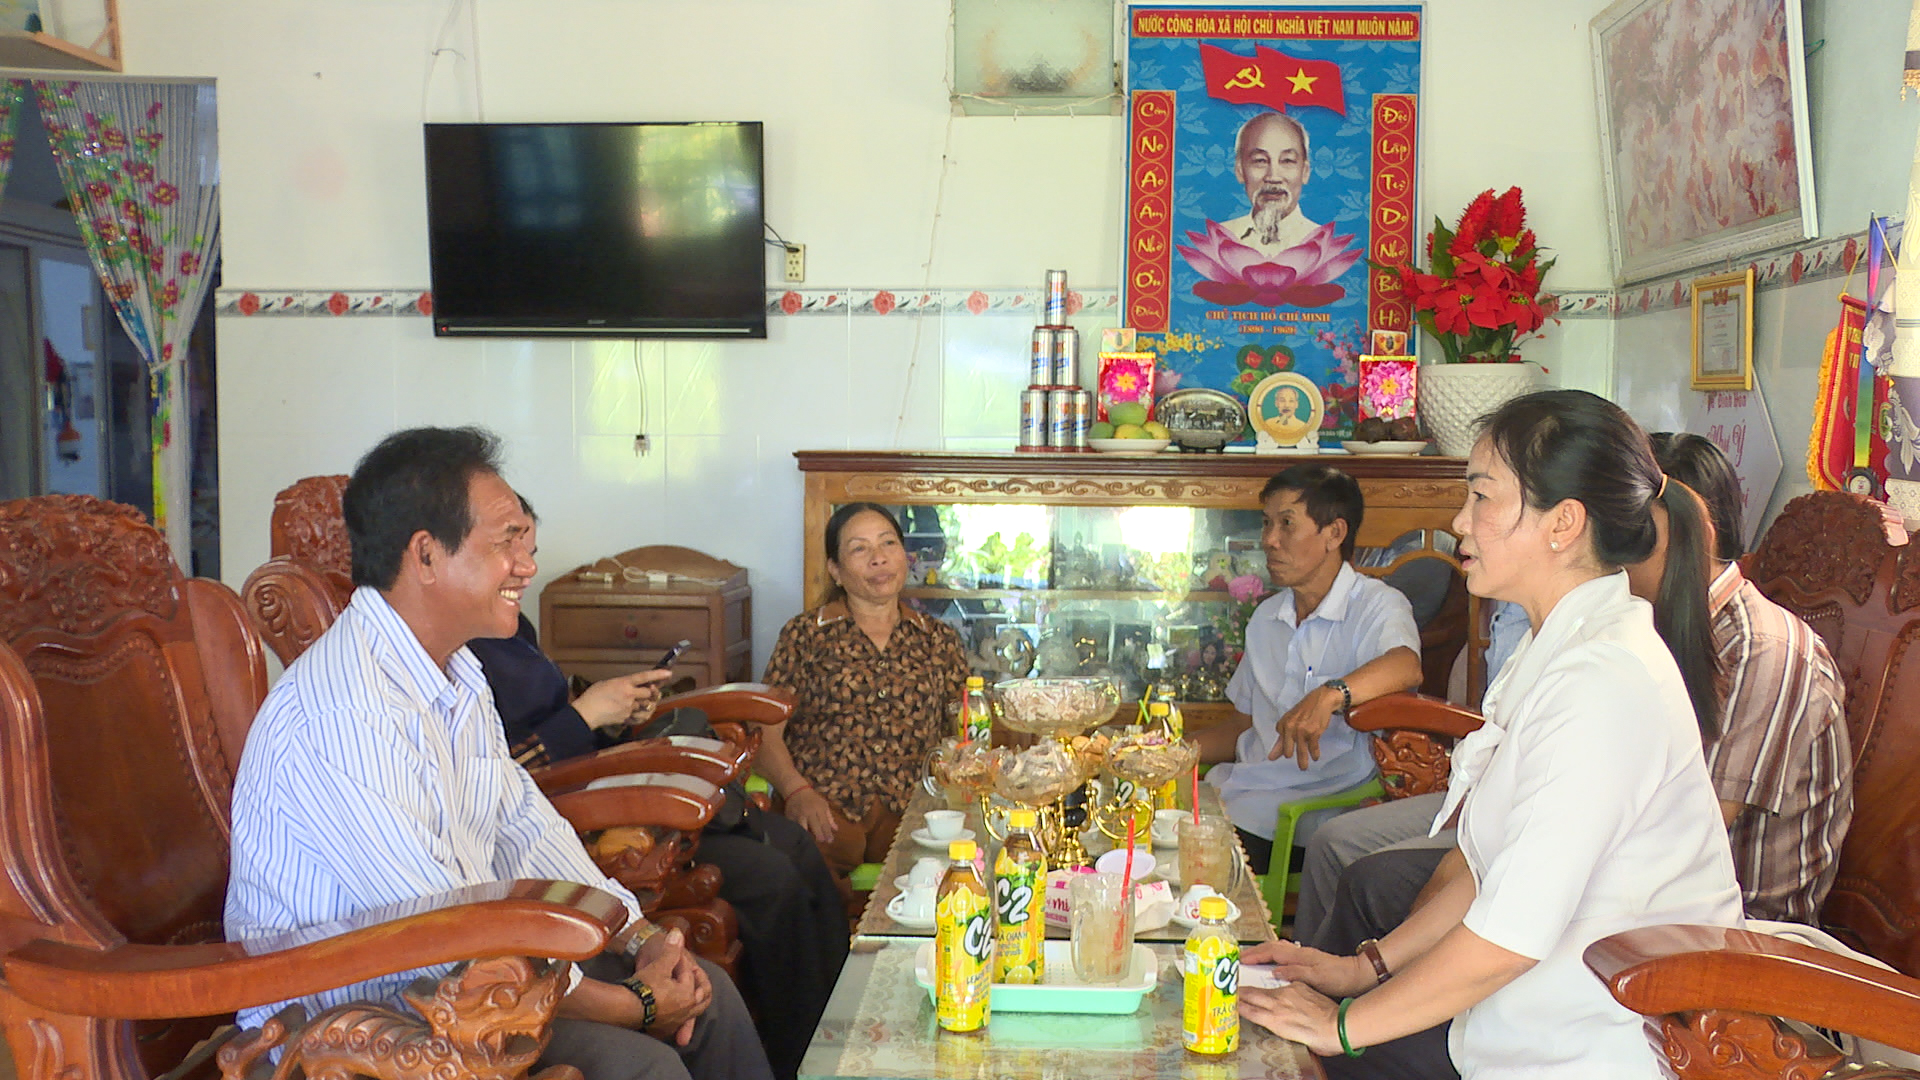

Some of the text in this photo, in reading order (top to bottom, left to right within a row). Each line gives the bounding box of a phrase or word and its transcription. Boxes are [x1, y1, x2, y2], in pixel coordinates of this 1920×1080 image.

[1138, 13, 1164, 33] NƯỚC
[1166, 13, 1193, 36] CỘNG
[1195, 14, 1215, 33] HÒA
[1218, 14, 1231, 33] XÃ
[1234, 14, 1251, 37] HỘI
[1253, 12, 1273, 34] CHỦ
[1276, 15, 1305, 34] NGHĨA
[1308, 15, 1330, 37] VIỆT
[1332, 19, 1354, 35] NAM
[1356, 15, 1386, 35] MUÔN
[1141, 136, 1164, 153] No
[1141, 167, 1164, 188] Áo
[1380, 174, 1406, 191] Tự
[1139, 199, 1163, 219] Ấm
[1380, 207, 1407, 225] Do
[1136, 269, 1160, 288] Ơn
[1205, 308, 1331, 322] CHỦ TỊCH HỒ CHÍ MINH
[998, 878, 1033, 924] C2
